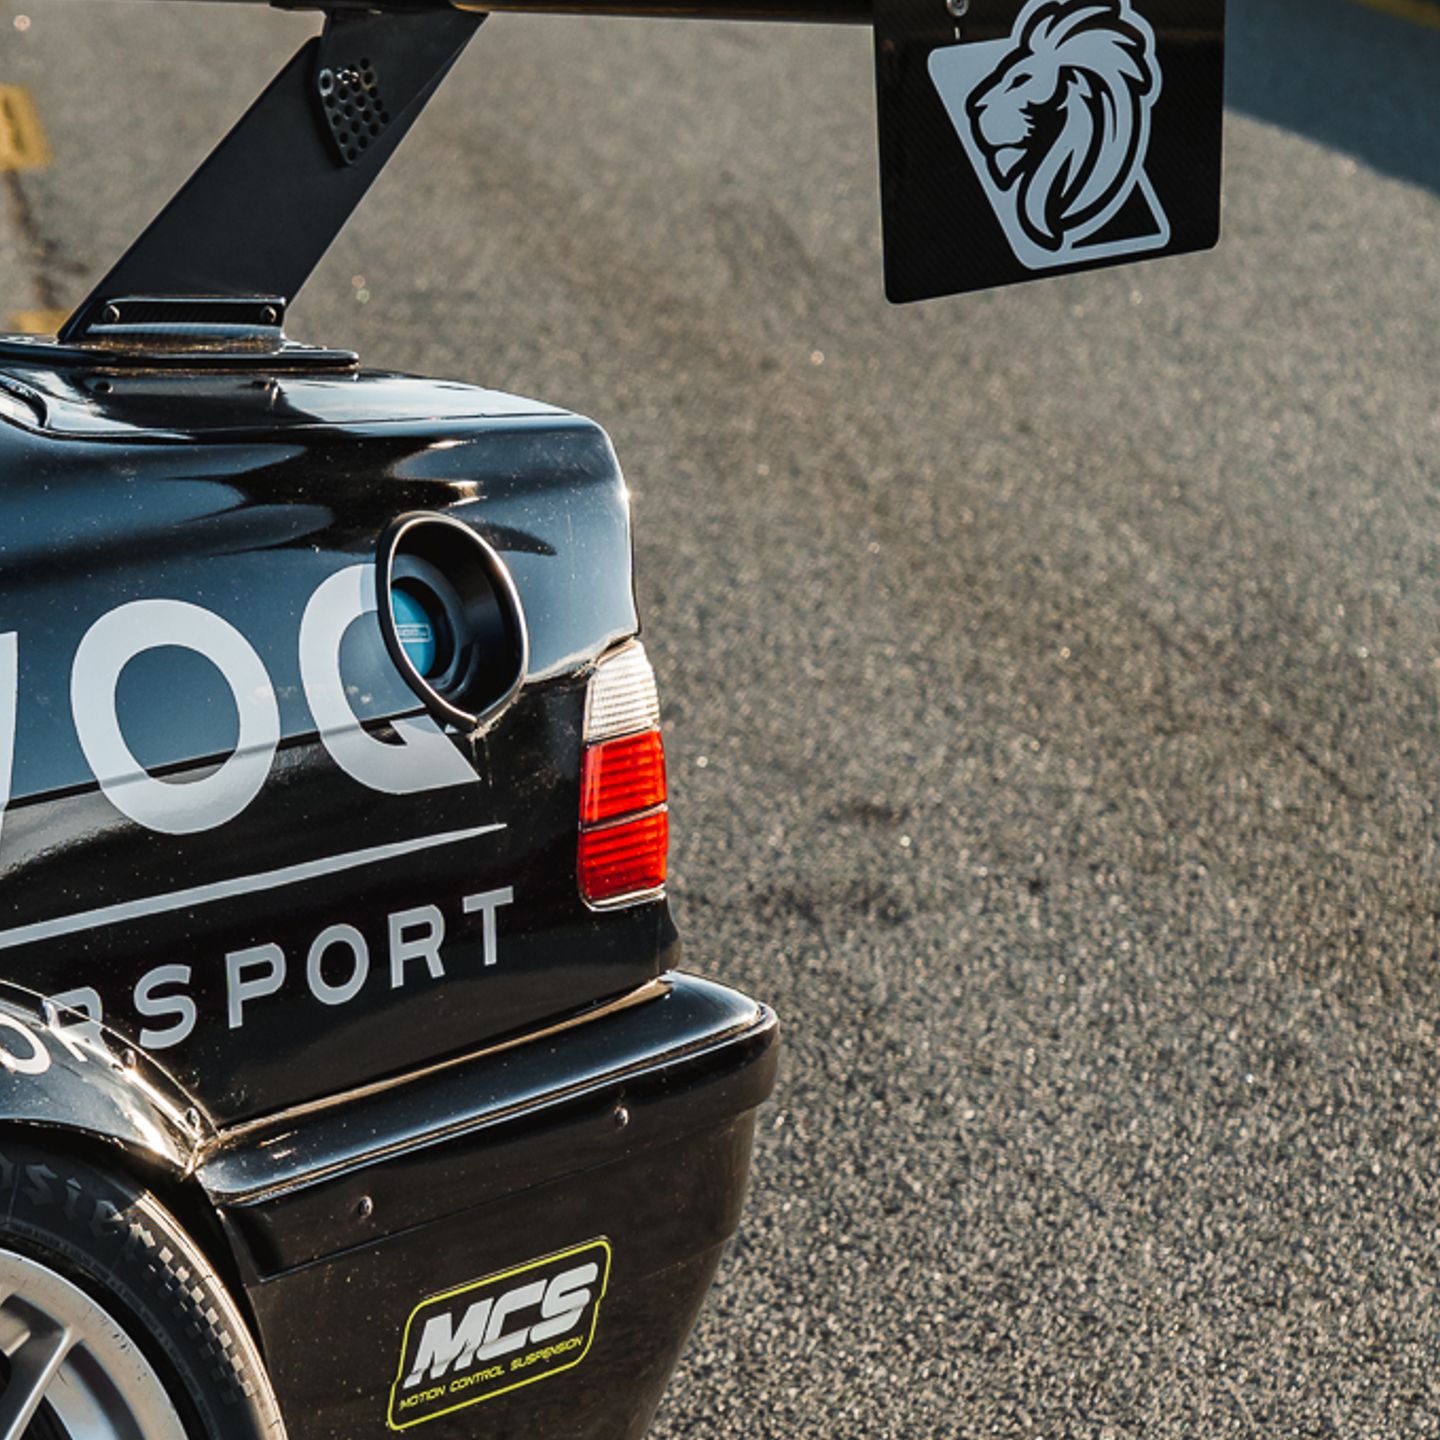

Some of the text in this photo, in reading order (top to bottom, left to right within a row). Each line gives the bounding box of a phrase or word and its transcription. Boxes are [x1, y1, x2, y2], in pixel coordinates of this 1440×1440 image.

[398, 1335, 584, 1410] MOTION CONTROL SUSPENSION
[402, 1261, 600, 1390] MCS
